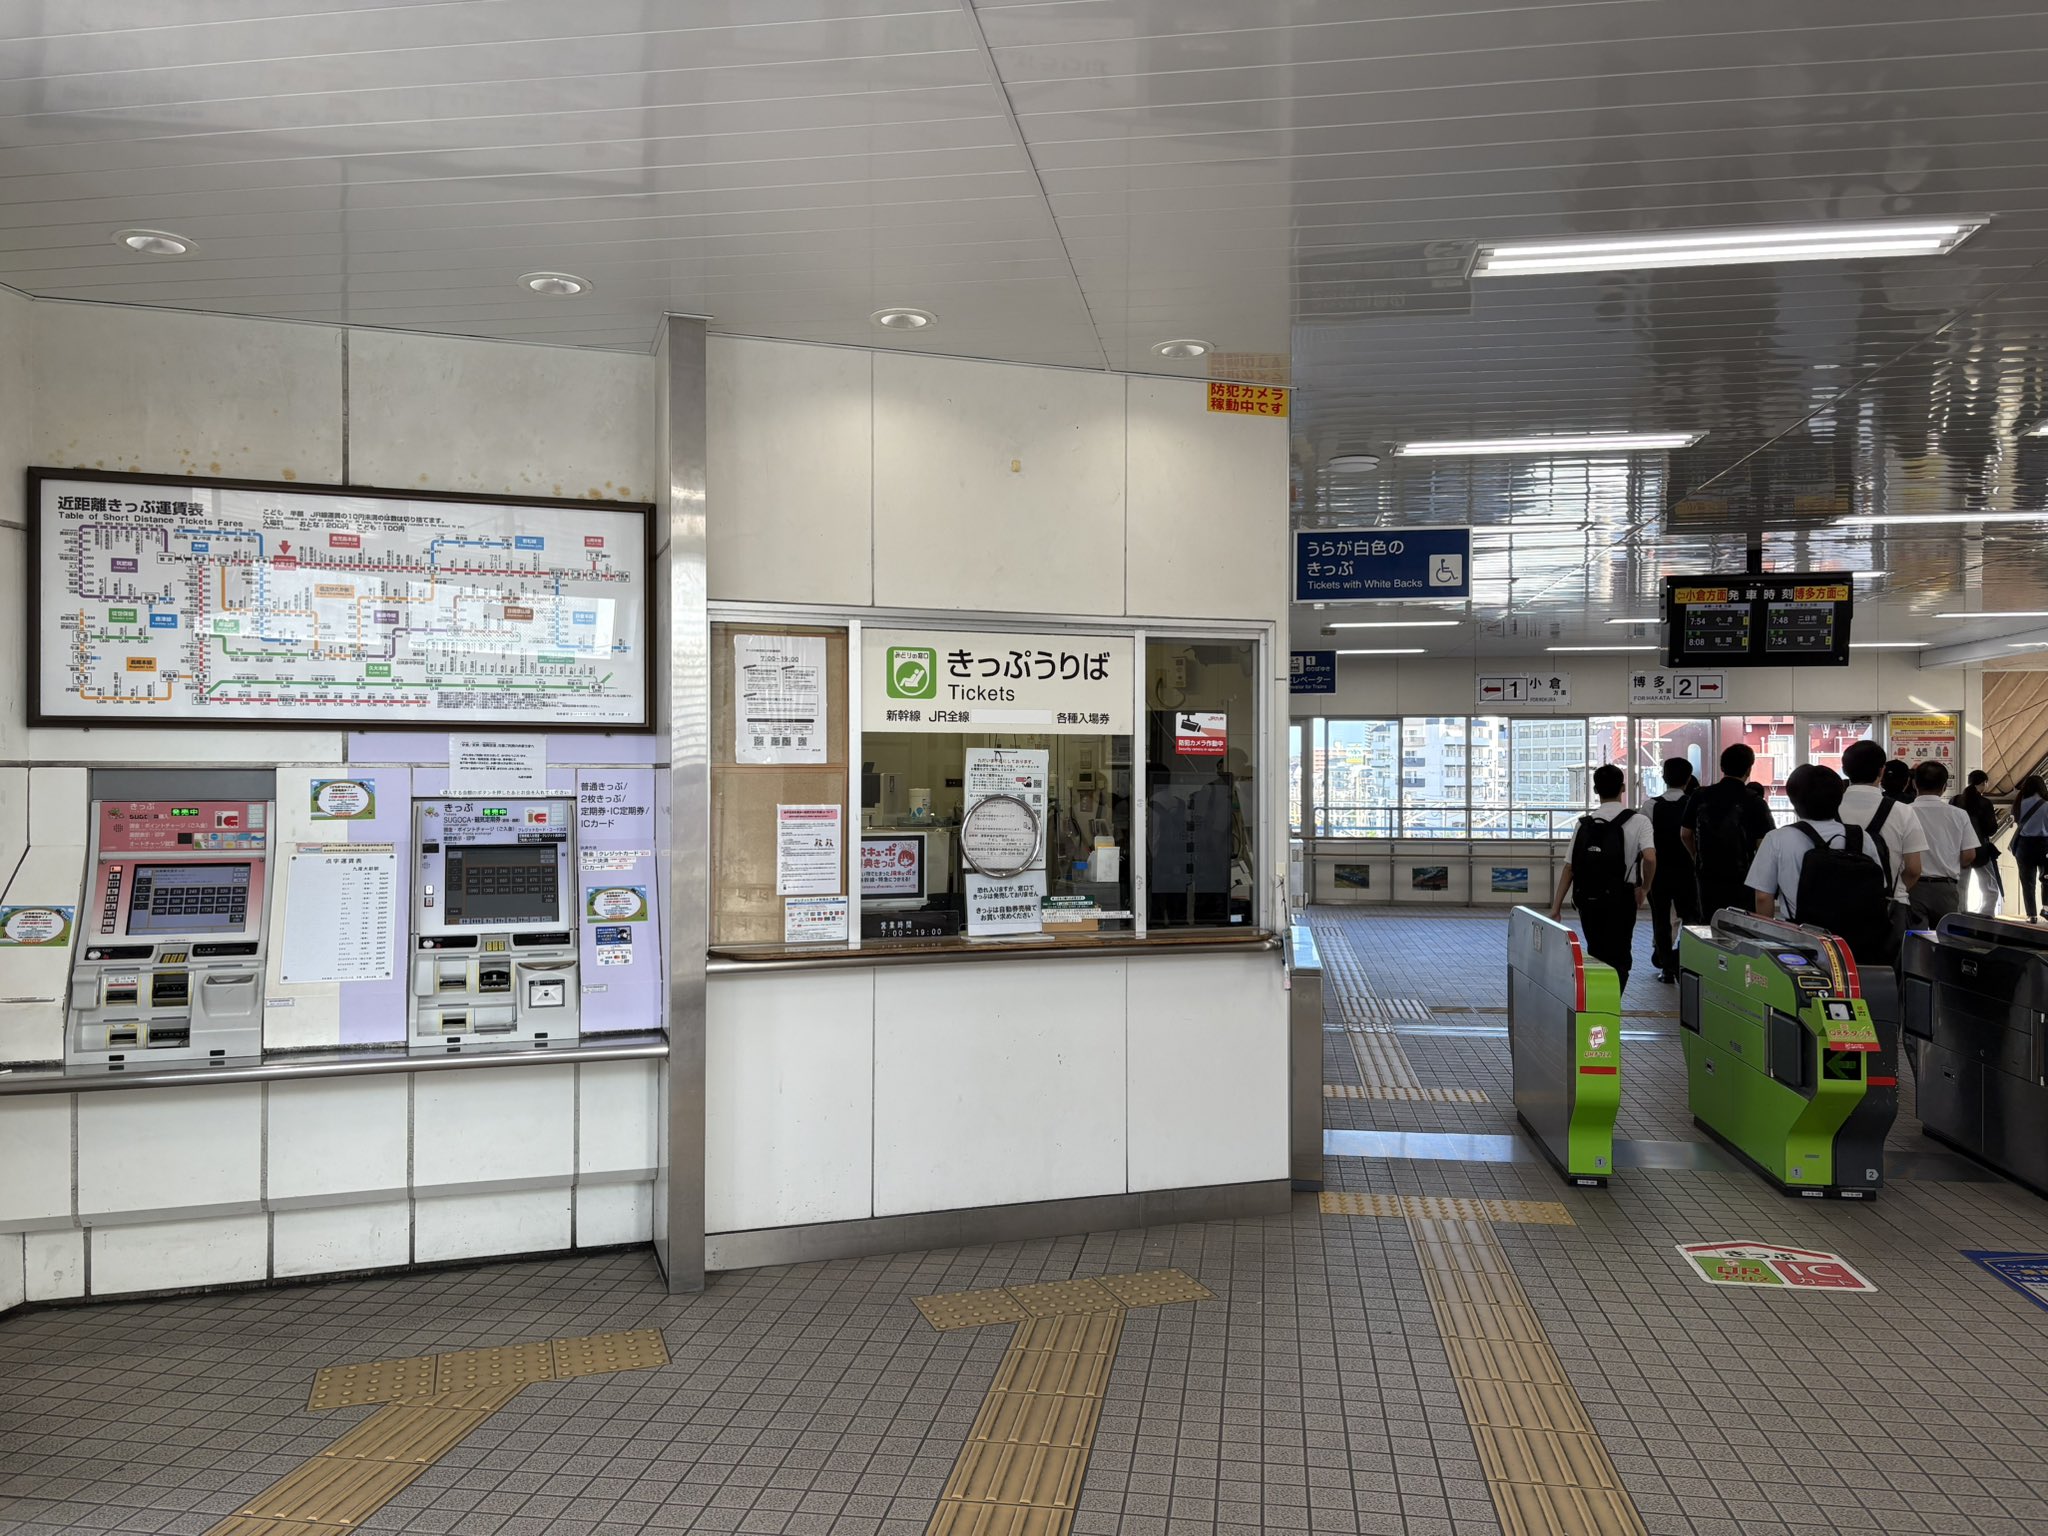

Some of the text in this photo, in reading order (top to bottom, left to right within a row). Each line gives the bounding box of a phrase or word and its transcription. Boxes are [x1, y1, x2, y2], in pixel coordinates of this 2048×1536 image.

[1211, 384, 1284, 400] 防犯カメラ
[1210, 397, 1283, 414] 稼動中です
[58, 496, 204, 516] 近距離きっぷ運賃表
[58, 512, 84, 520] Table
[103, 514, 129, 522] Short
[134, 515, 174, 524] Distance
[180, 517, 214, 526] Tickets
[217, 519, 244, 527] Fares
[1308, 540, 1404, 557] うらが白色の
[1307, 560, 1354, 576] きっぷ
[1308, 579, 1422, 590] Tickets with White Backs
[1686, 588, 1728, 601] 小倉方面
[1728, 588, 1794, 600] 発車時刻
[1795, 587, 1837, 600] 博多方面
[1690, 617, 1706, 625] 7:54
[1772, 616, 1788, 624] 7:48
[1689, 638, 1704, 646] 8:08
[1771, 638, 1787, 646] 7:54
[894, 651, 929, 660] みどりの窓口
[947, 648, 1110, 680] きっぷうりば
[1509, 680, 1519, 698] 1
[1529, 677, 1562, 690] 小倉
[1634, 676, 1665, 688] 博多
[1678, 678, 1692, 696] 2
[948, 684, 1015, 702] Tickets
[886, 710, 1110, 724] 新幹線 JR全線 各種入場券
[580, 794, 626, 804] 2枚きっぷ/
[172, 808, 200, 816] 発売中
[444, 803, 508, 816] きっぷ 発売中
[580, 819, 615, 828] ICカード
[976, 884, 1034, 894] 恐れ入りますが、窓口で
[973, 891, 1039, 900] きっぷは発売しておりません
[976, 904, 1038, 914] きっぷは自動券売機で
[981, 912, 1034, 922] お買い求めください
[880, 920, 912, 930] 営業時間
[1868, 1170, 1875, 1178] 2
[1725, 1250, 1798, 1260] きっぷ
[1787, 1263, 1842, 1278] IC
